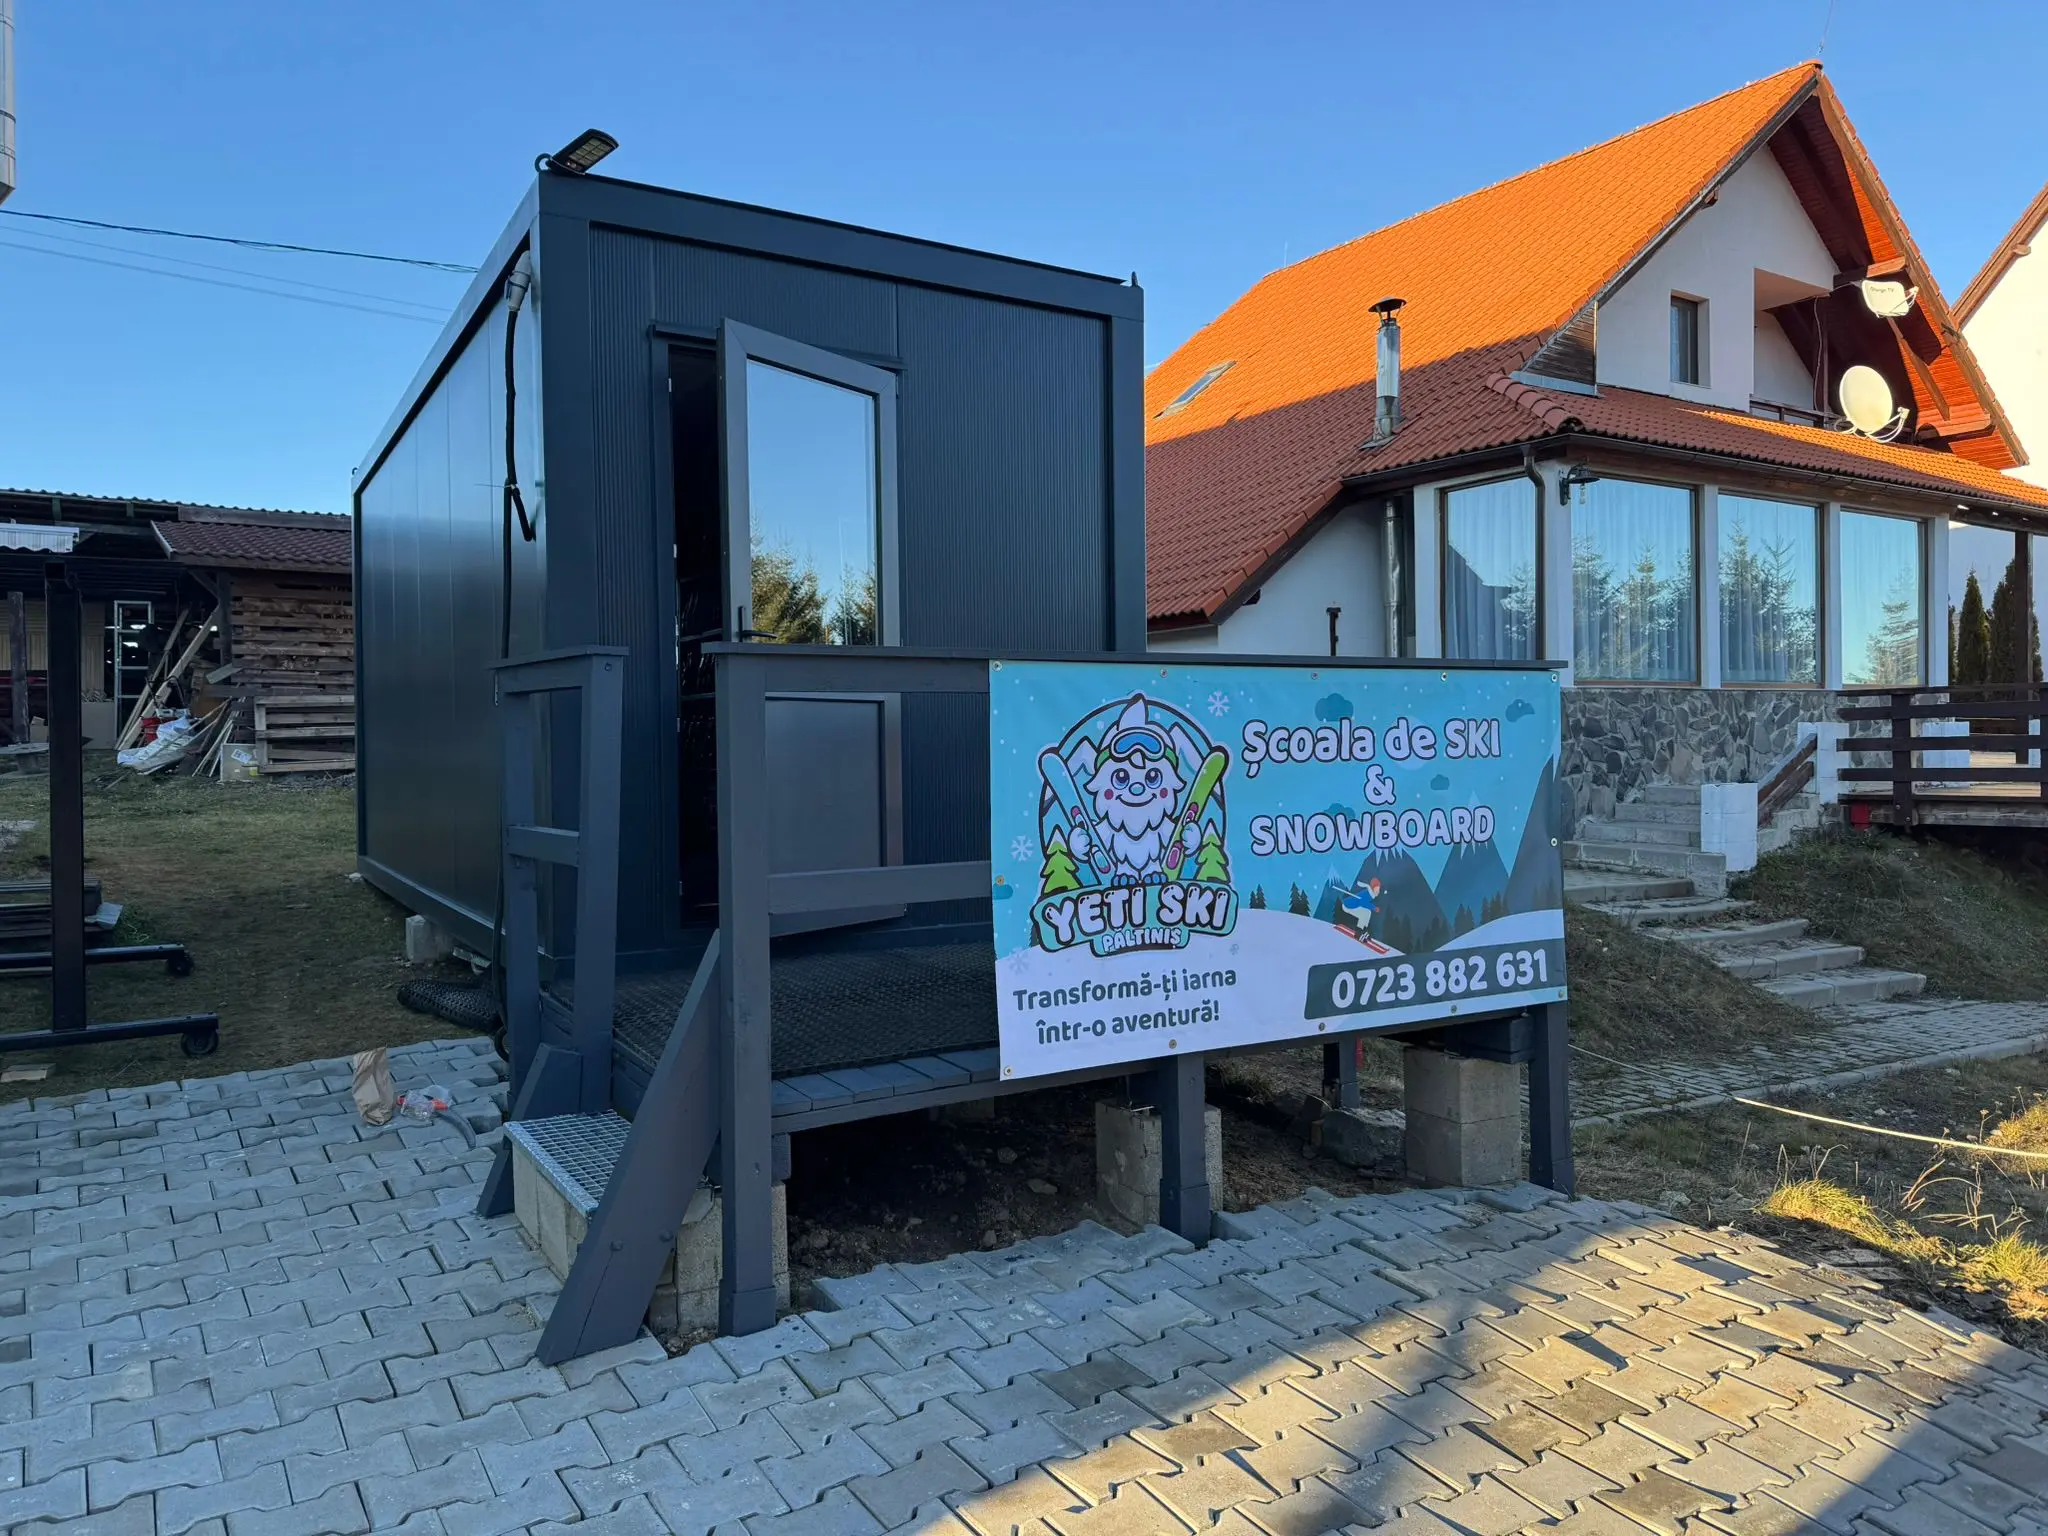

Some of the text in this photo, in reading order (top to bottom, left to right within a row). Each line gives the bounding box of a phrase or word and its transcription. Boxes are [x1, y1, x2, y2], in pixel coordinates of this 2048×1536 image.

[1242, 716, 1501, 778] Școala de SKI
[1364, 764, 1396, 805] &
[1250, 805, 1495, 856] SNOWBOARD
[1044, 883, 1230, 944] YETI SKI
[1012, 968, 1238, 1011] Transformă-ți iarna
[1331, 948, 1548, 1009] 0723 882 631
[1036, 999, 1220, 1044] într-o aventură!
